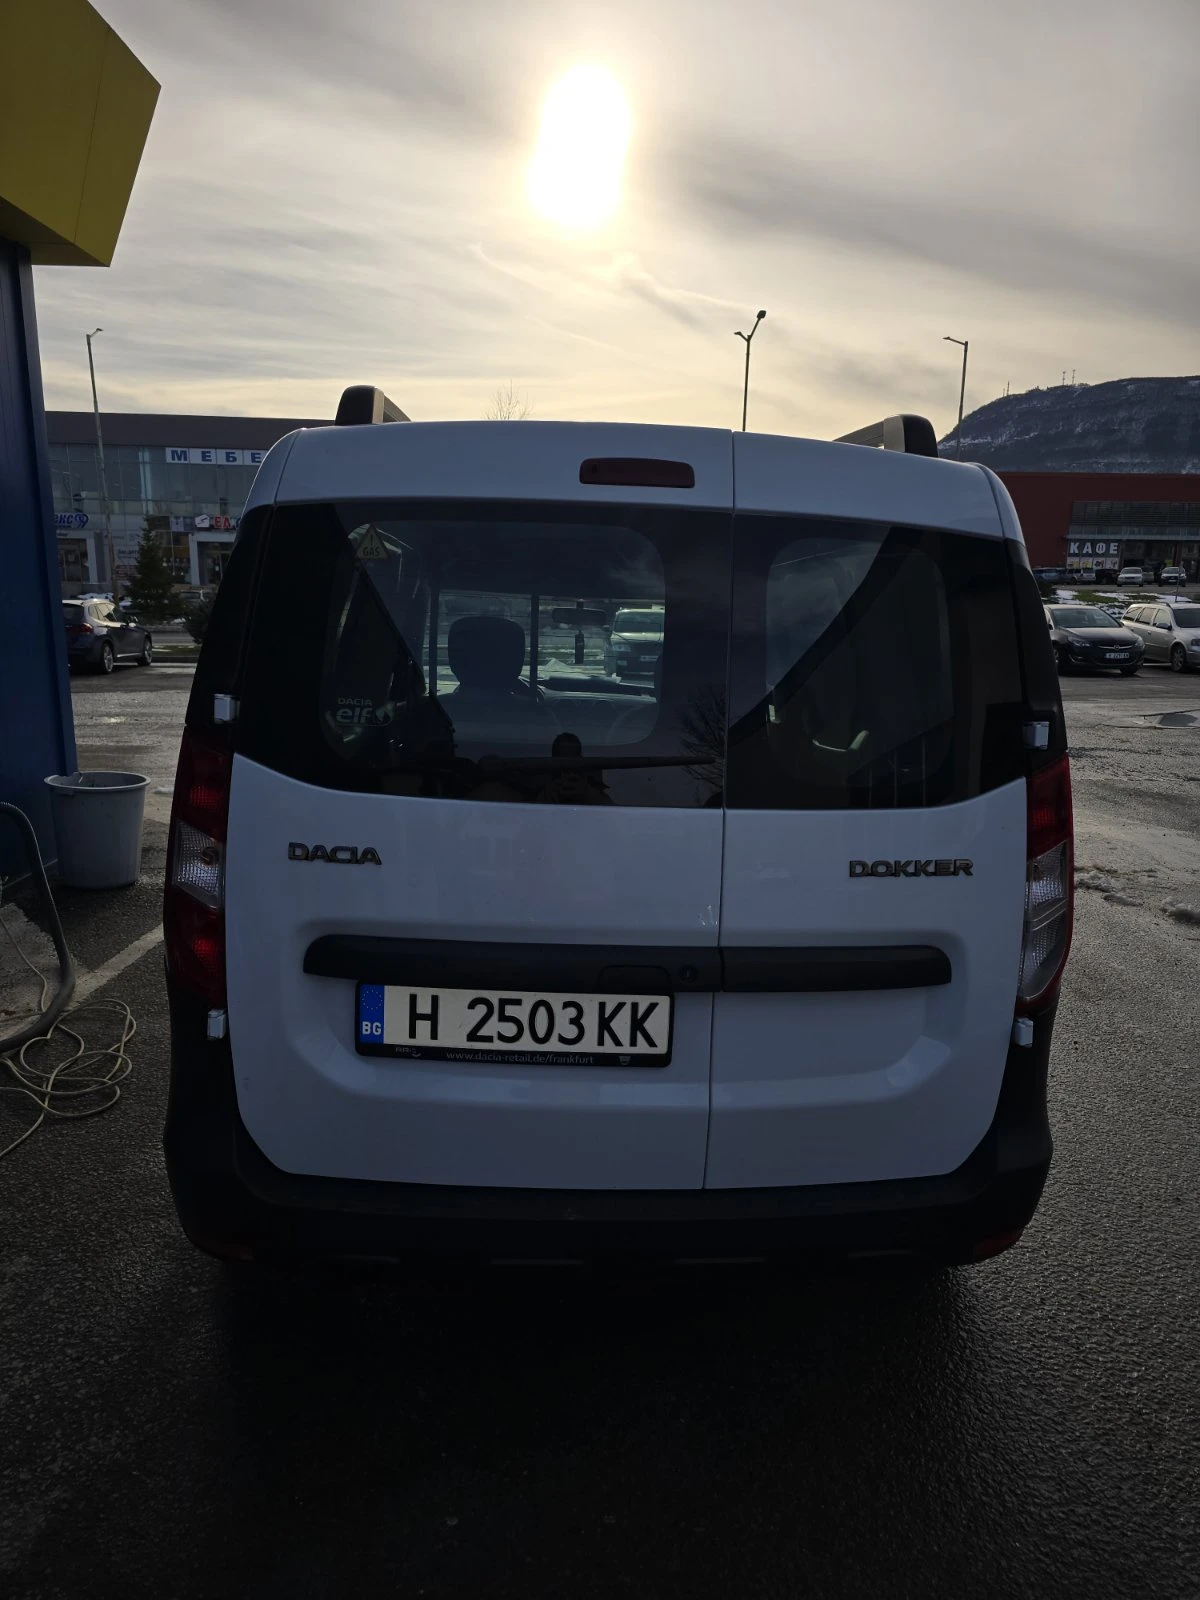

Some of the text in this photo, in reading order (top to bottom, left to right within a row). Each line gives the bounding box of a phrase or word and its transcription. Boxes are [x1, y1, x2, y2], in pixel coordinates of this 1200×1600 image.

[171, 449, 262, 464] МЕБЕ
[362, 546, 381, 557] GAS
[1069, 542, 1119, 555] КАФЕ
[337, 697, 374, 707] DACIA
[335, 707, 374, 724] elf
[288, 841, 382, 865] DACIA
[849, 858, 974, 878] DOKKER
[408, 993, 660, 1048] H 2503 KK
[362, 1021, 382, 1036] BG
[446, 1051, 594, 1065] www.dacia-retail.de/frankfurt
